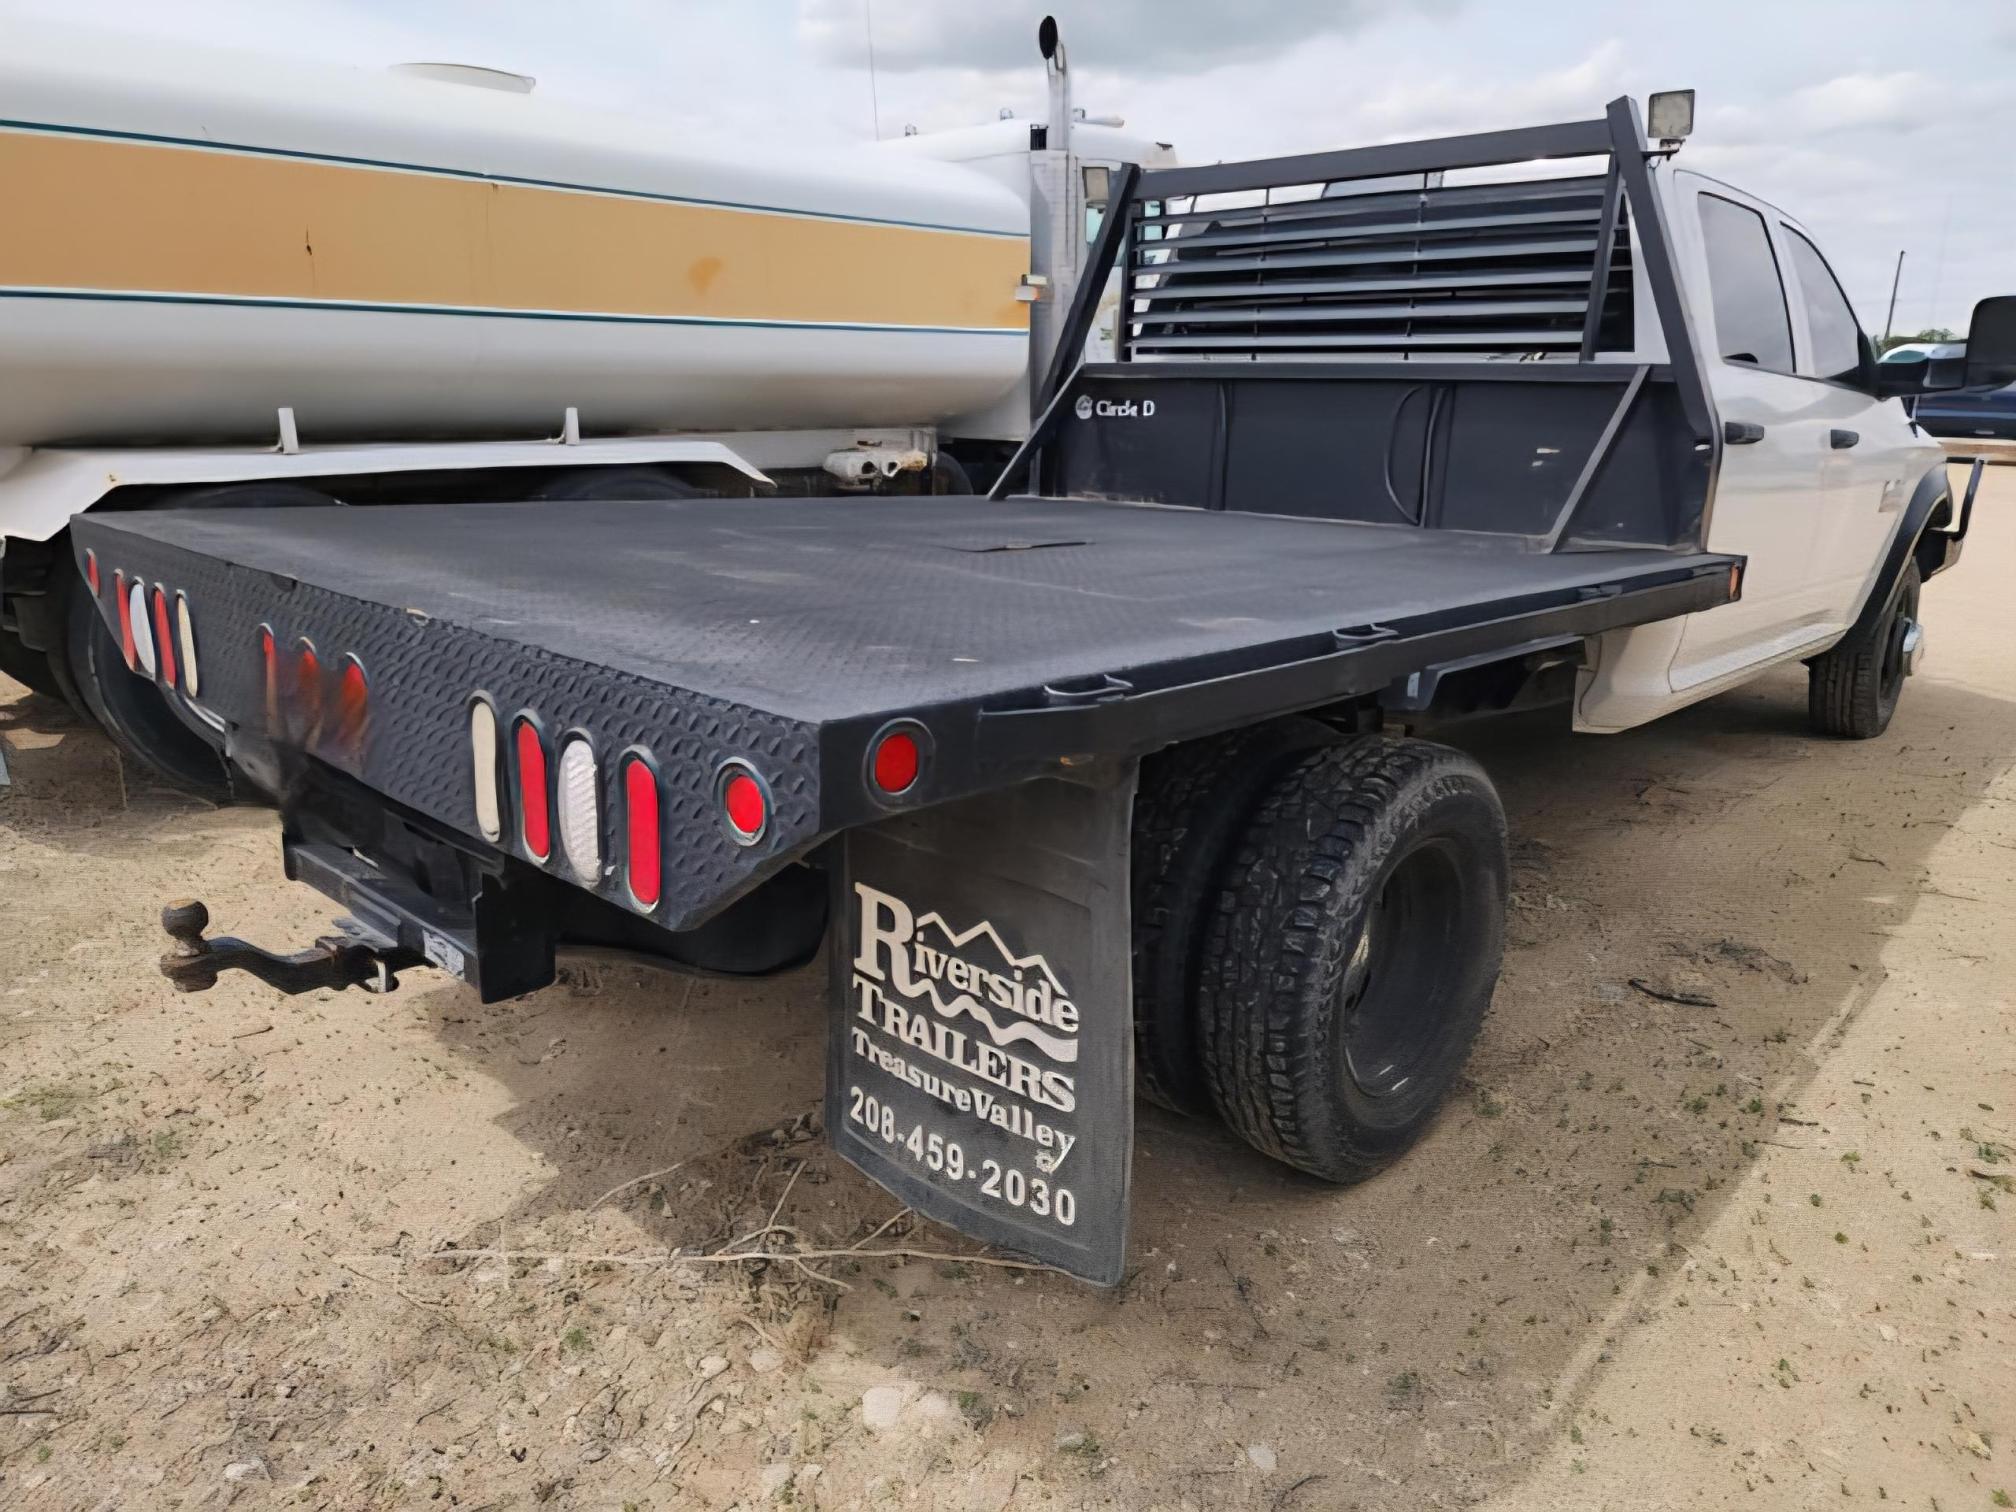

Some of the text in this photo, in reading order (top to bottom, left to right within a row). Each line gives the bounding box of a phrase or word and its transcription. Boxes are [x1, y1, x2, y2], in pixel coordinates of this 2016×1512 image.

[1143, 400, 1155, 416] D
[854, 881, 1079, 1033] Riverside
[853, 973, 1076, 1113] TRAILERS
